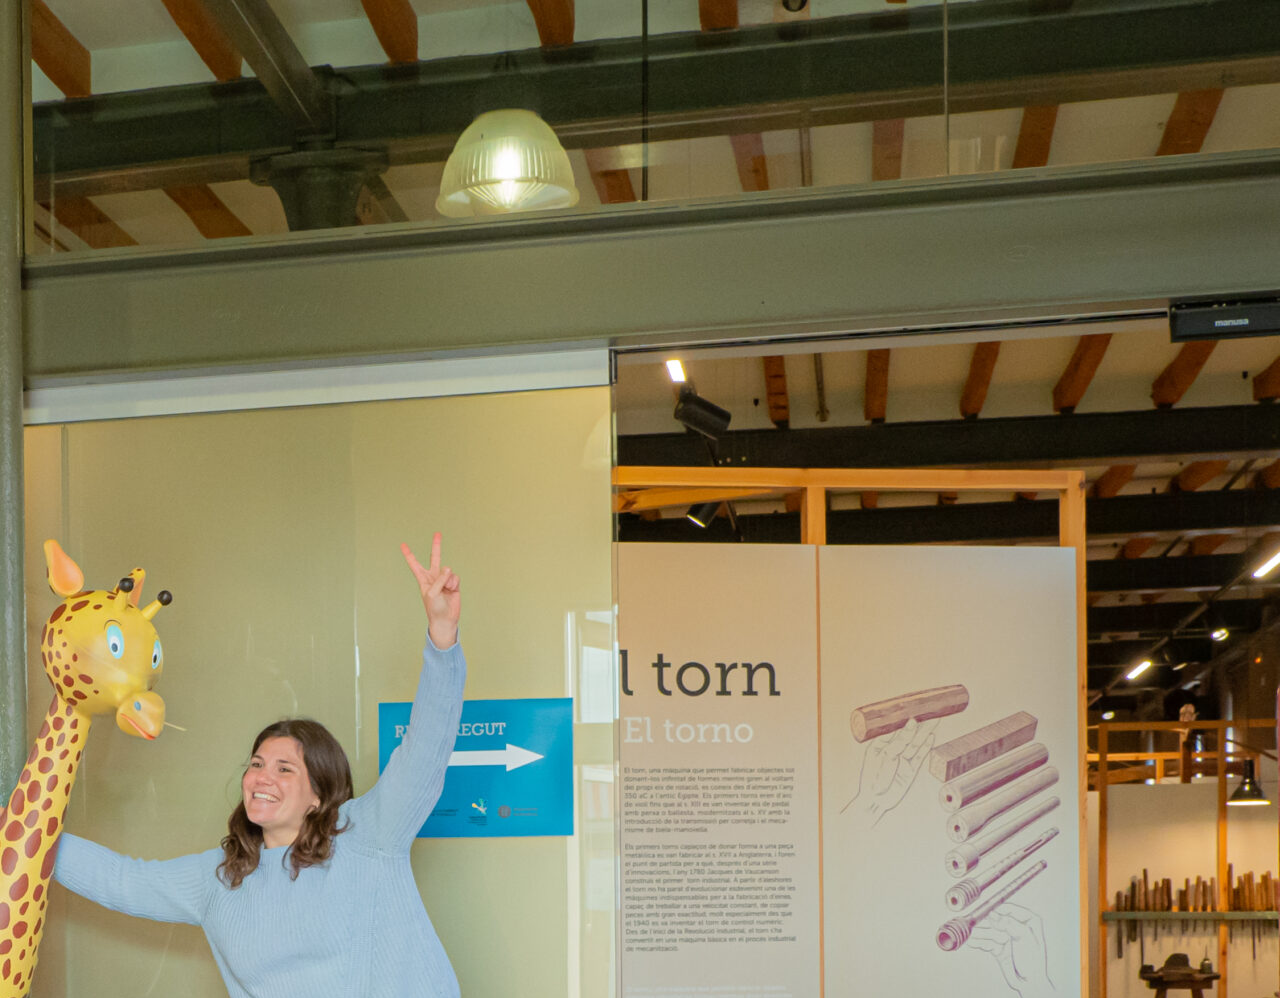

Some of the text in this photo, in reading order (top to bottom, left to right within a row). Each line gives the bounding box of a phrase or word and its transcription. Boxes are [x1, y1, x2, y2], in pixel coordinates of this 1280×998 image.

[619, 649, 781, 697] l torn
[394, 722, 507, 739] REGUT
[623, 716, 754, 744] El torno
